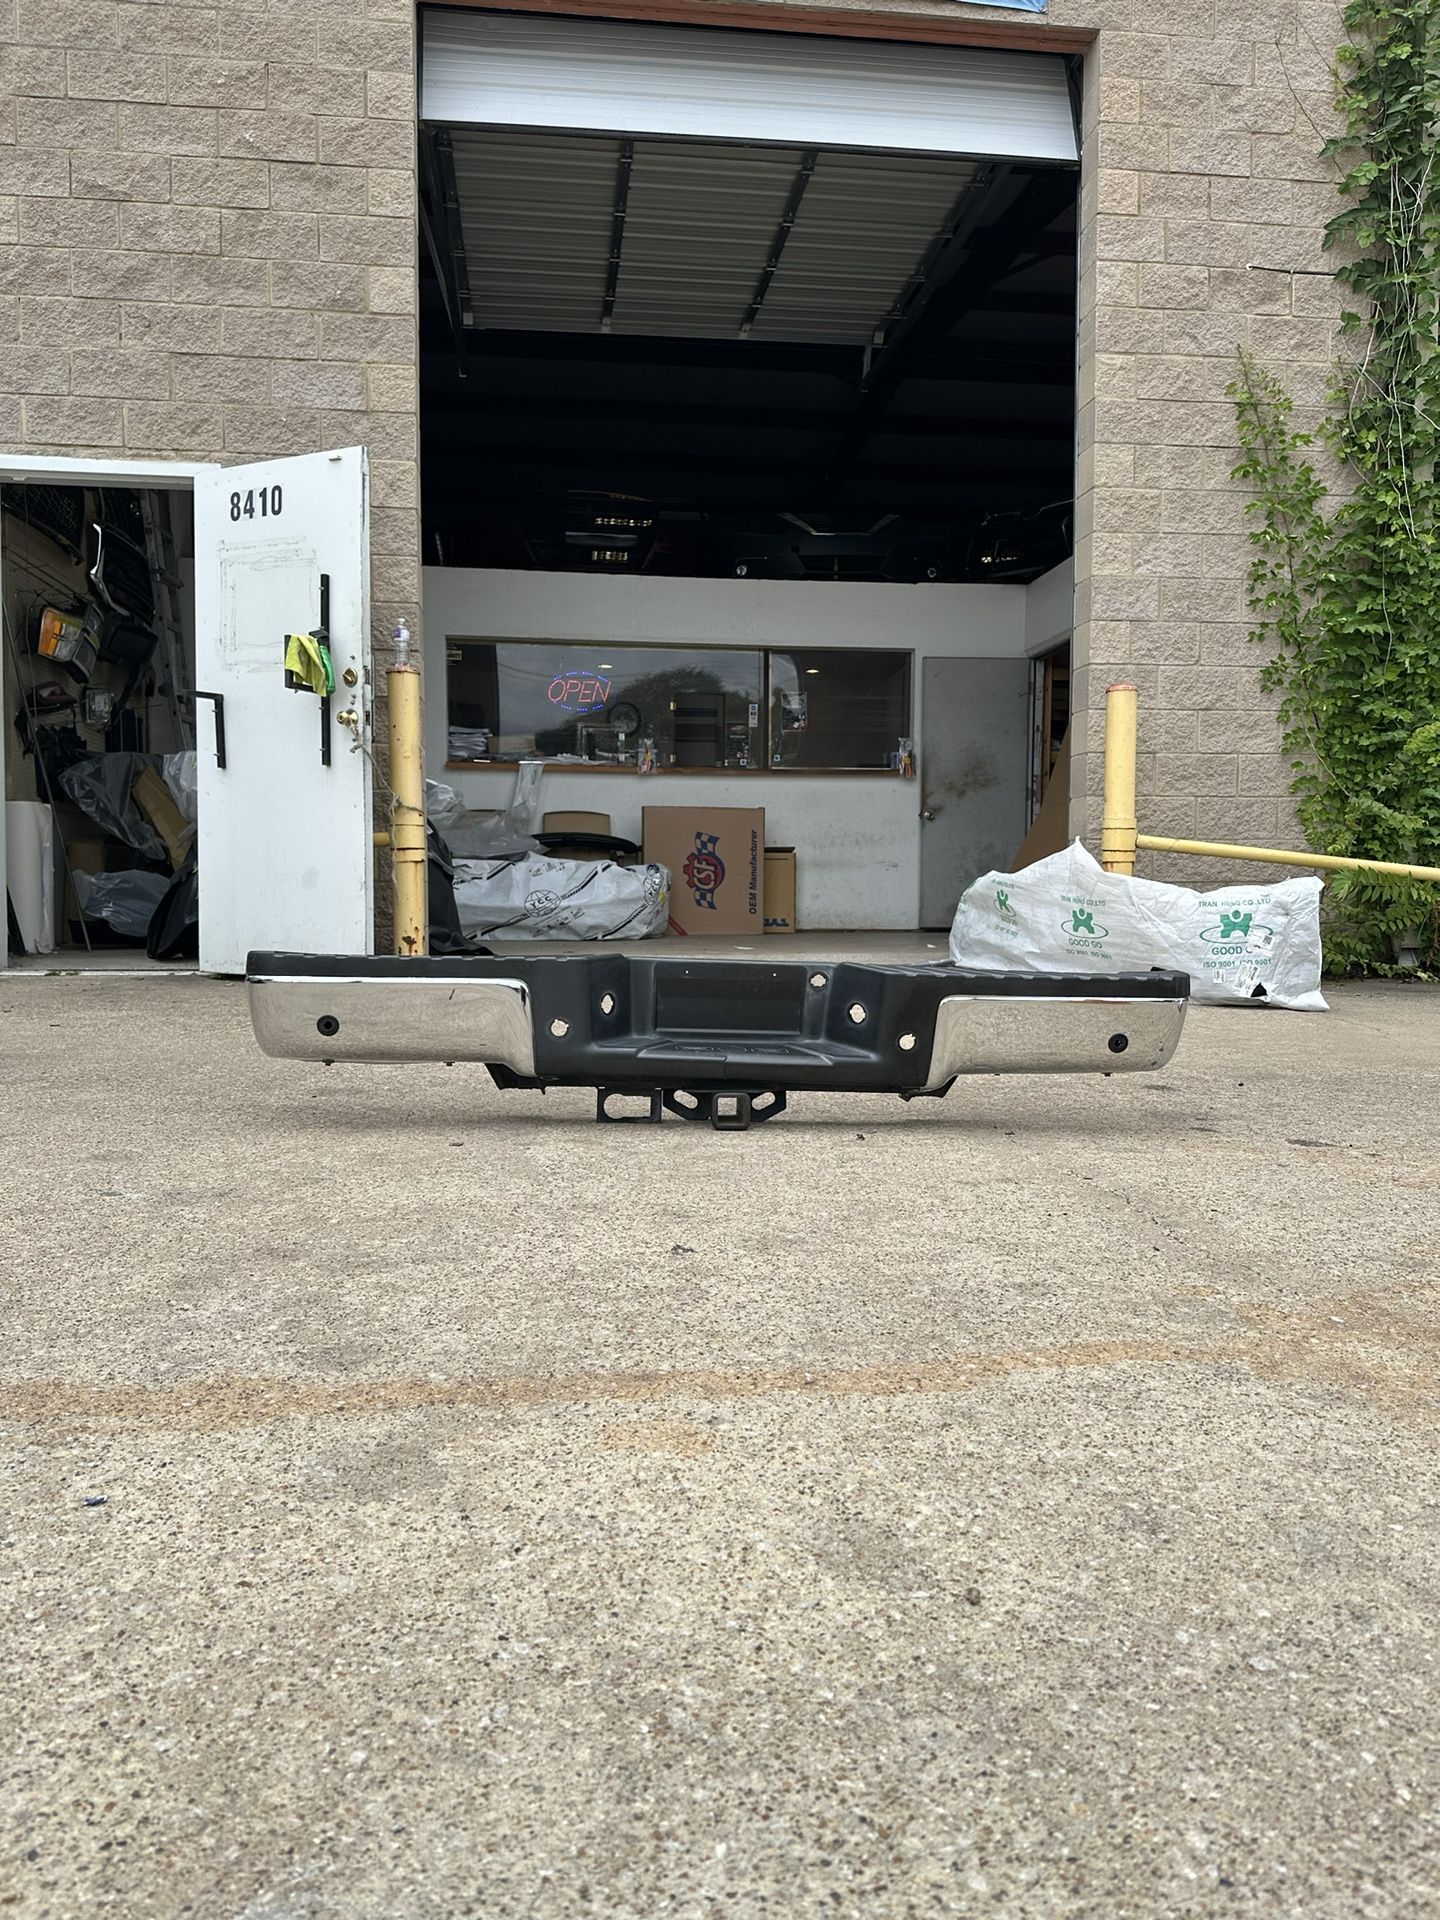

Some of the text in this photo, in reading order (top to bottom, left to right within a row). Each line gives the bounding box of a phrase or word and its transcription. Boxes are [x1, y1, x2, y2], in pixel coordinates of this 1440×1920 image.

[230, 485, 283, 521] 8410
[548, 679, 611, 703] OPEN
[693, 860, 715, 890] CSF
[749, 830, 757, 914] OEM Manufacturer
[529, 895, 551, 909] YCC
[1068, 938, 1090, 947] GOOD
[1211, 946, 1243, 955] GOOD
[1254, 958, 1271, 966] 9001
